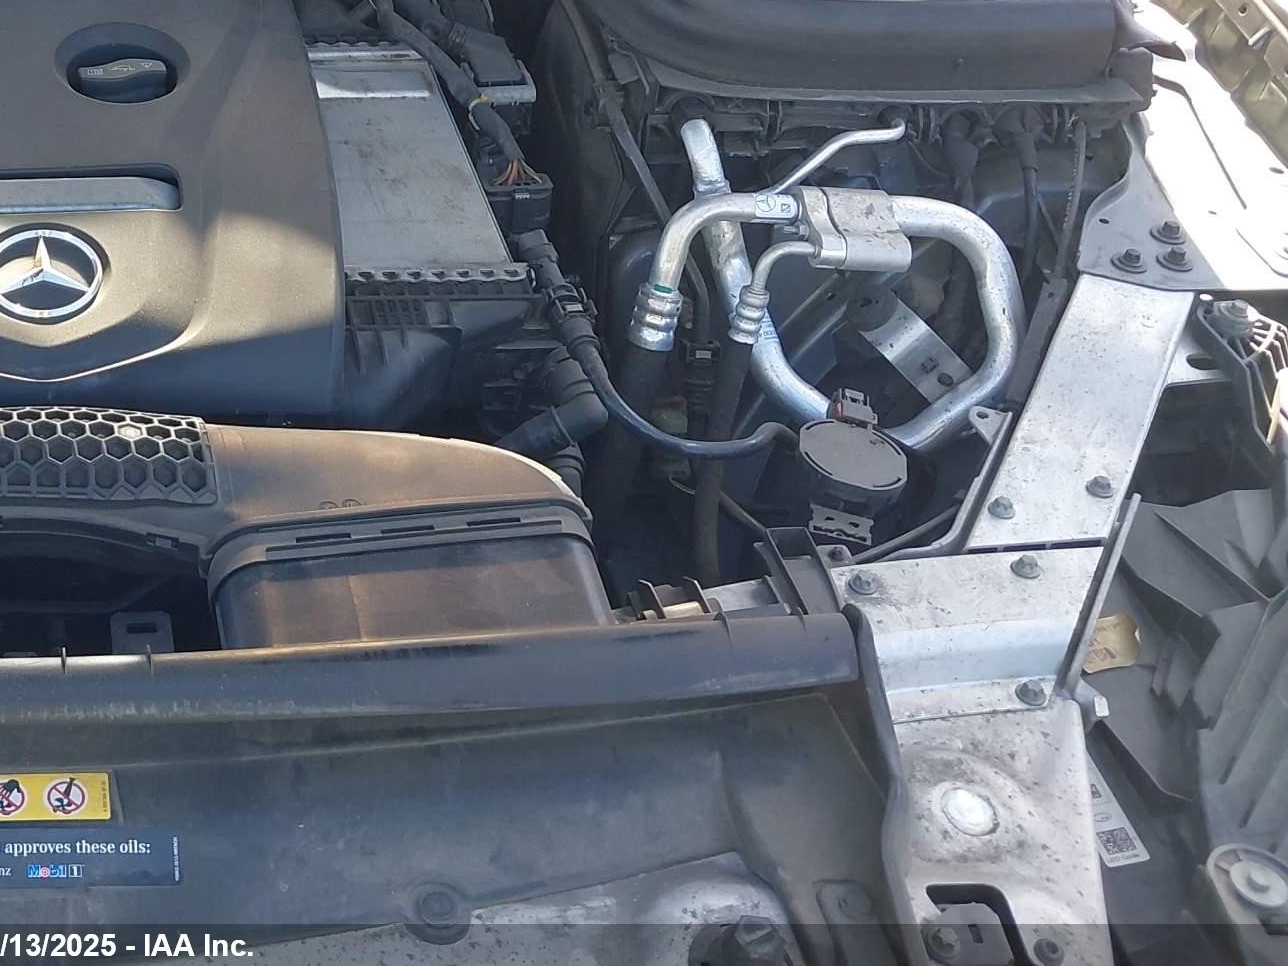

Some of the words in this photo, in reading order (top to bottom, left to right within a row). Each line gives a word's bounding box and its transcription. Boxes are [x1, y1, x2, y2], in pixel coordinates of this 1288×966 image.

[4, 842, 72, 858] approves
[75, 839, 116, 854] these
[119, 839, 151, 854] oils:
[27, 864, 67, 878] Mobil
